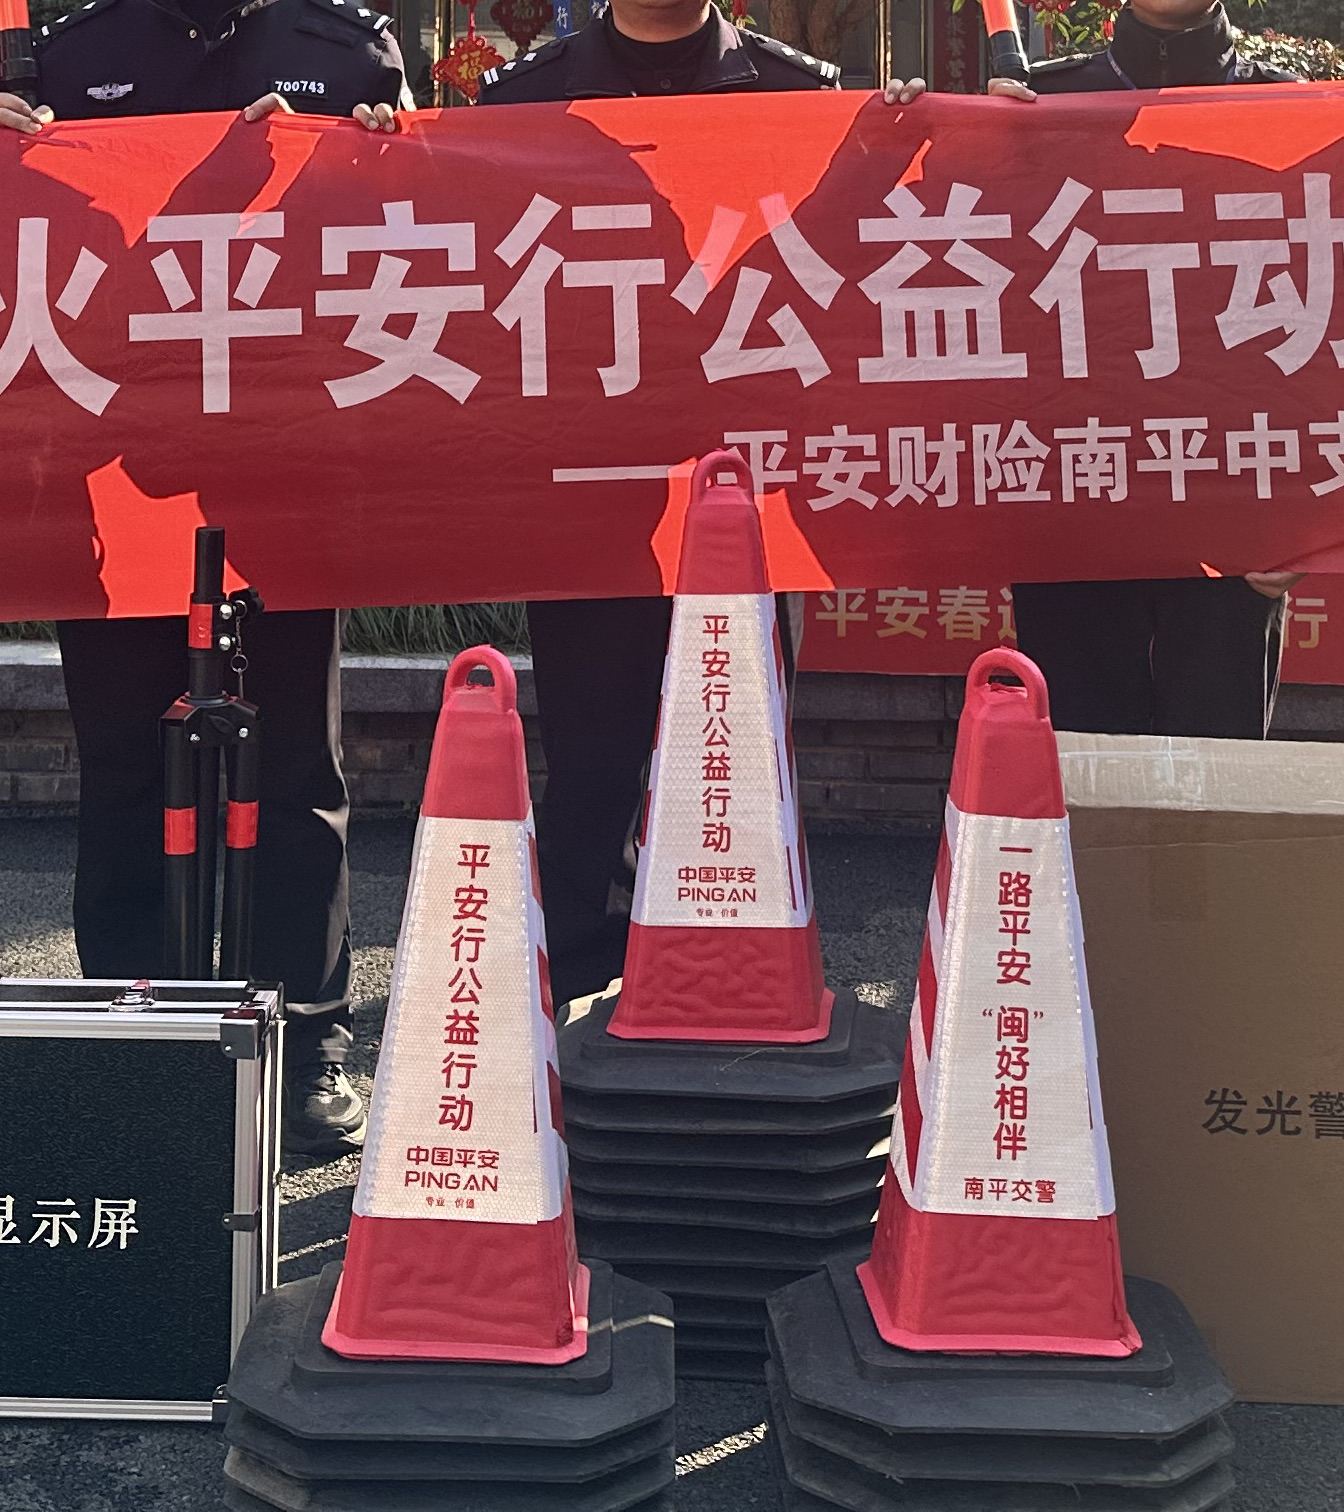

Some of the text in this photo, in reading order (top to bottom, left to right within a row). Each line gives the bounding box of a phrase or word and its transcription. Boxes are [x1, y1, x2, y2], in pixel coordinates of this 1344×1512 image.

[458, 51, 485, 80] 福
[274, 80, 325, 94] 700743
[701, 614, 732, 853] 平安行公益行动
[677, 866, 756, 884] 中国平安
[437, 843, 491, 1132] 平安行公益行动
[406, 1145, 500, 1170] 中国平安
[964, 1177, 1057, 1204] 南平交警
